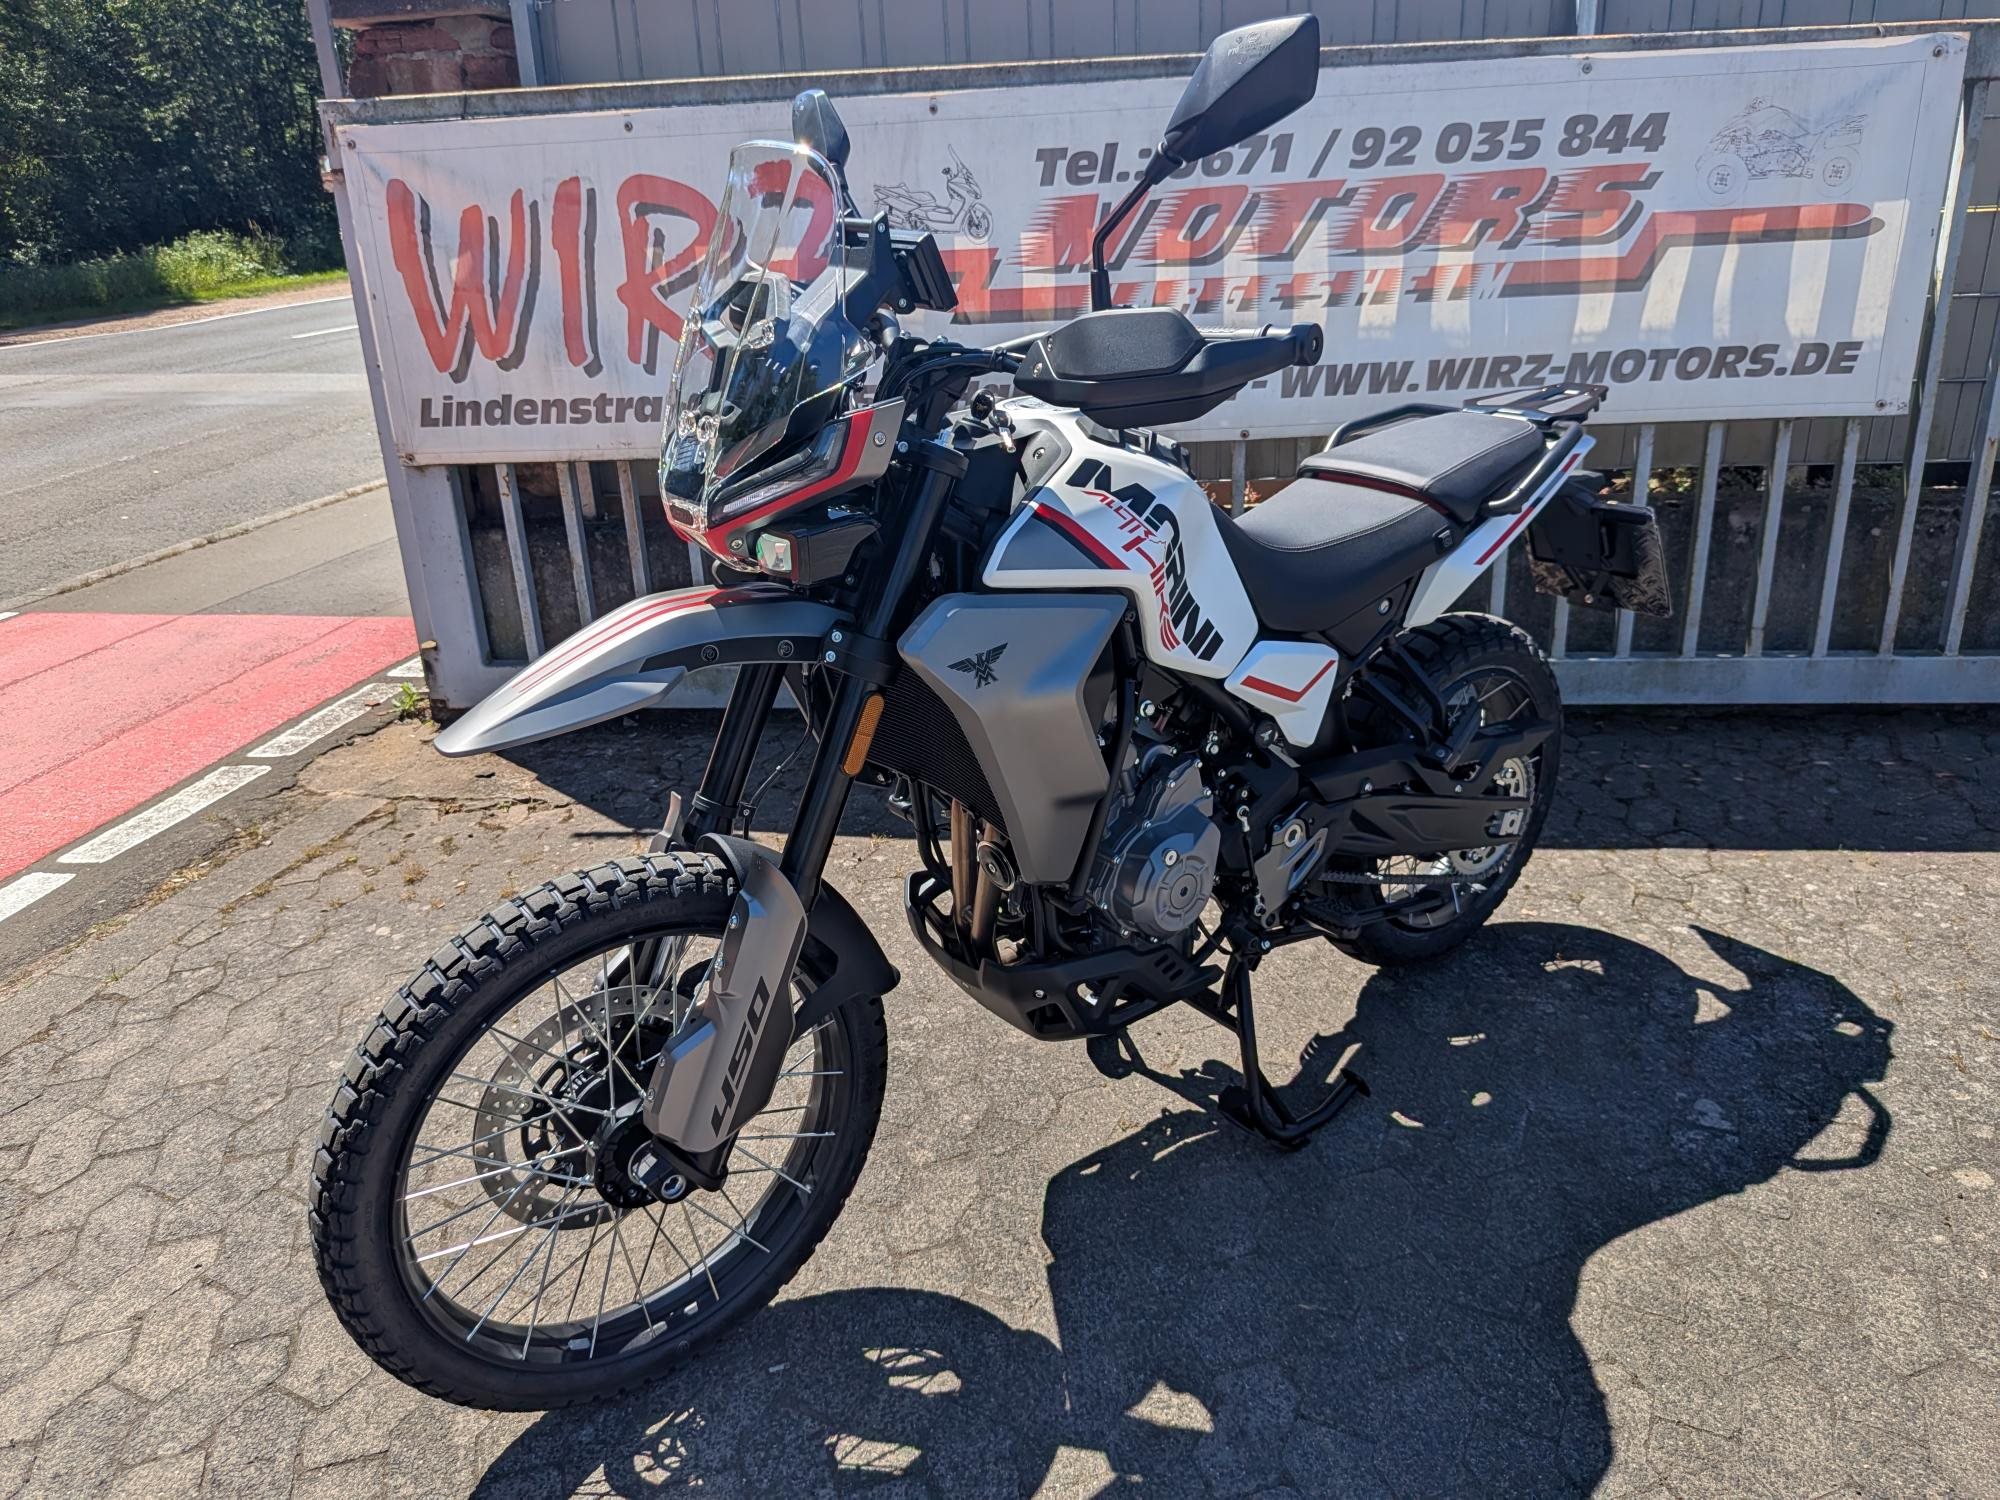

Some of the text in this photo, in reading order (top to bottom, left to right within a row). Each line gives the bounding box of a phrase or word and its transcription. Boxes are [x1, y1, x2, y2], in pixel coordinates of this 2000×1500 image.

[1166, 133, 1295, 180] 671
[1307, 128, 1343, 178] /
[1350, 125, 1423, 170] 92
[1434, 118, 1546, 164] 035
[1557, 111, 1671, 158] 844
[1018, 162, 1664, 275] MOTORS
[711, 975, 771, 1138] 450
